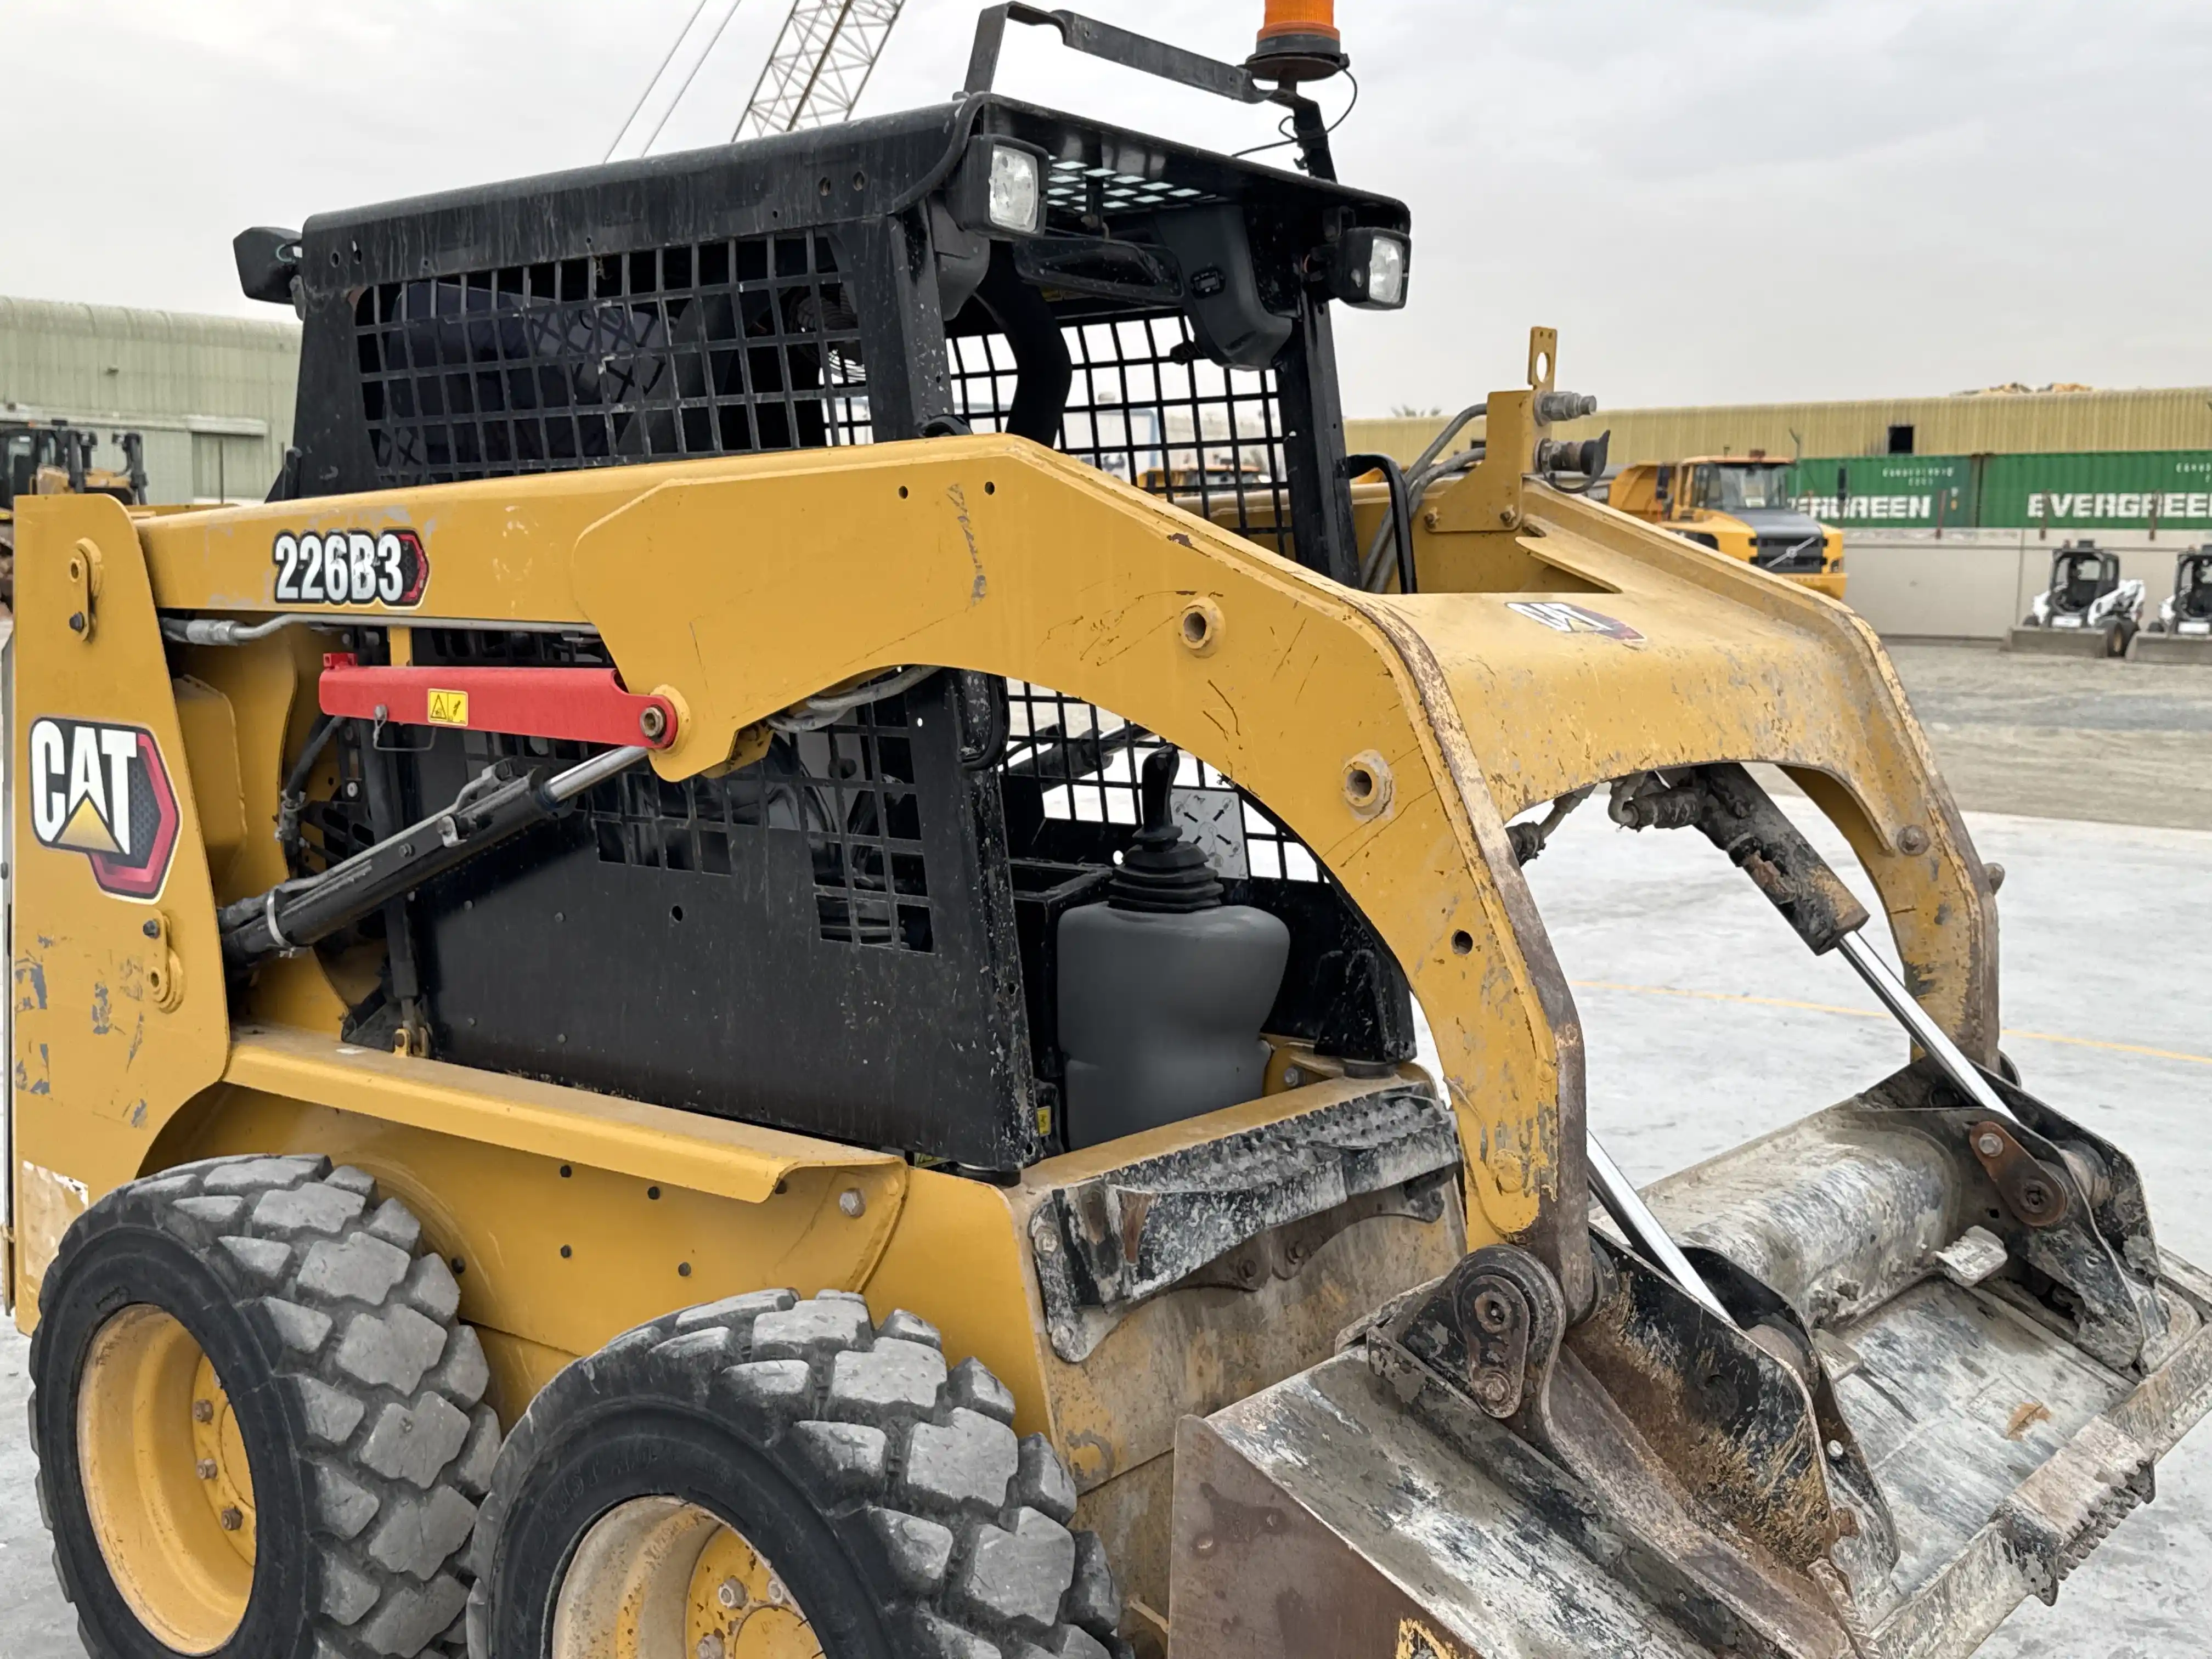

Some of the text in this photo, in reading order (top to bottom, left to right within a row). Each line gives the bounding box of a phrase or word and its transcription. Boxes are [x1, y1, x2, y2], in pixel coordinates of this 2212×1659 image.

[1787, 494, 1932, 519] ERGREEN
[2027, 492, 2212, 518] EVERGREE
[275, 534, 403, 601] 226B3
[32, 720, 137, 855] CAT
